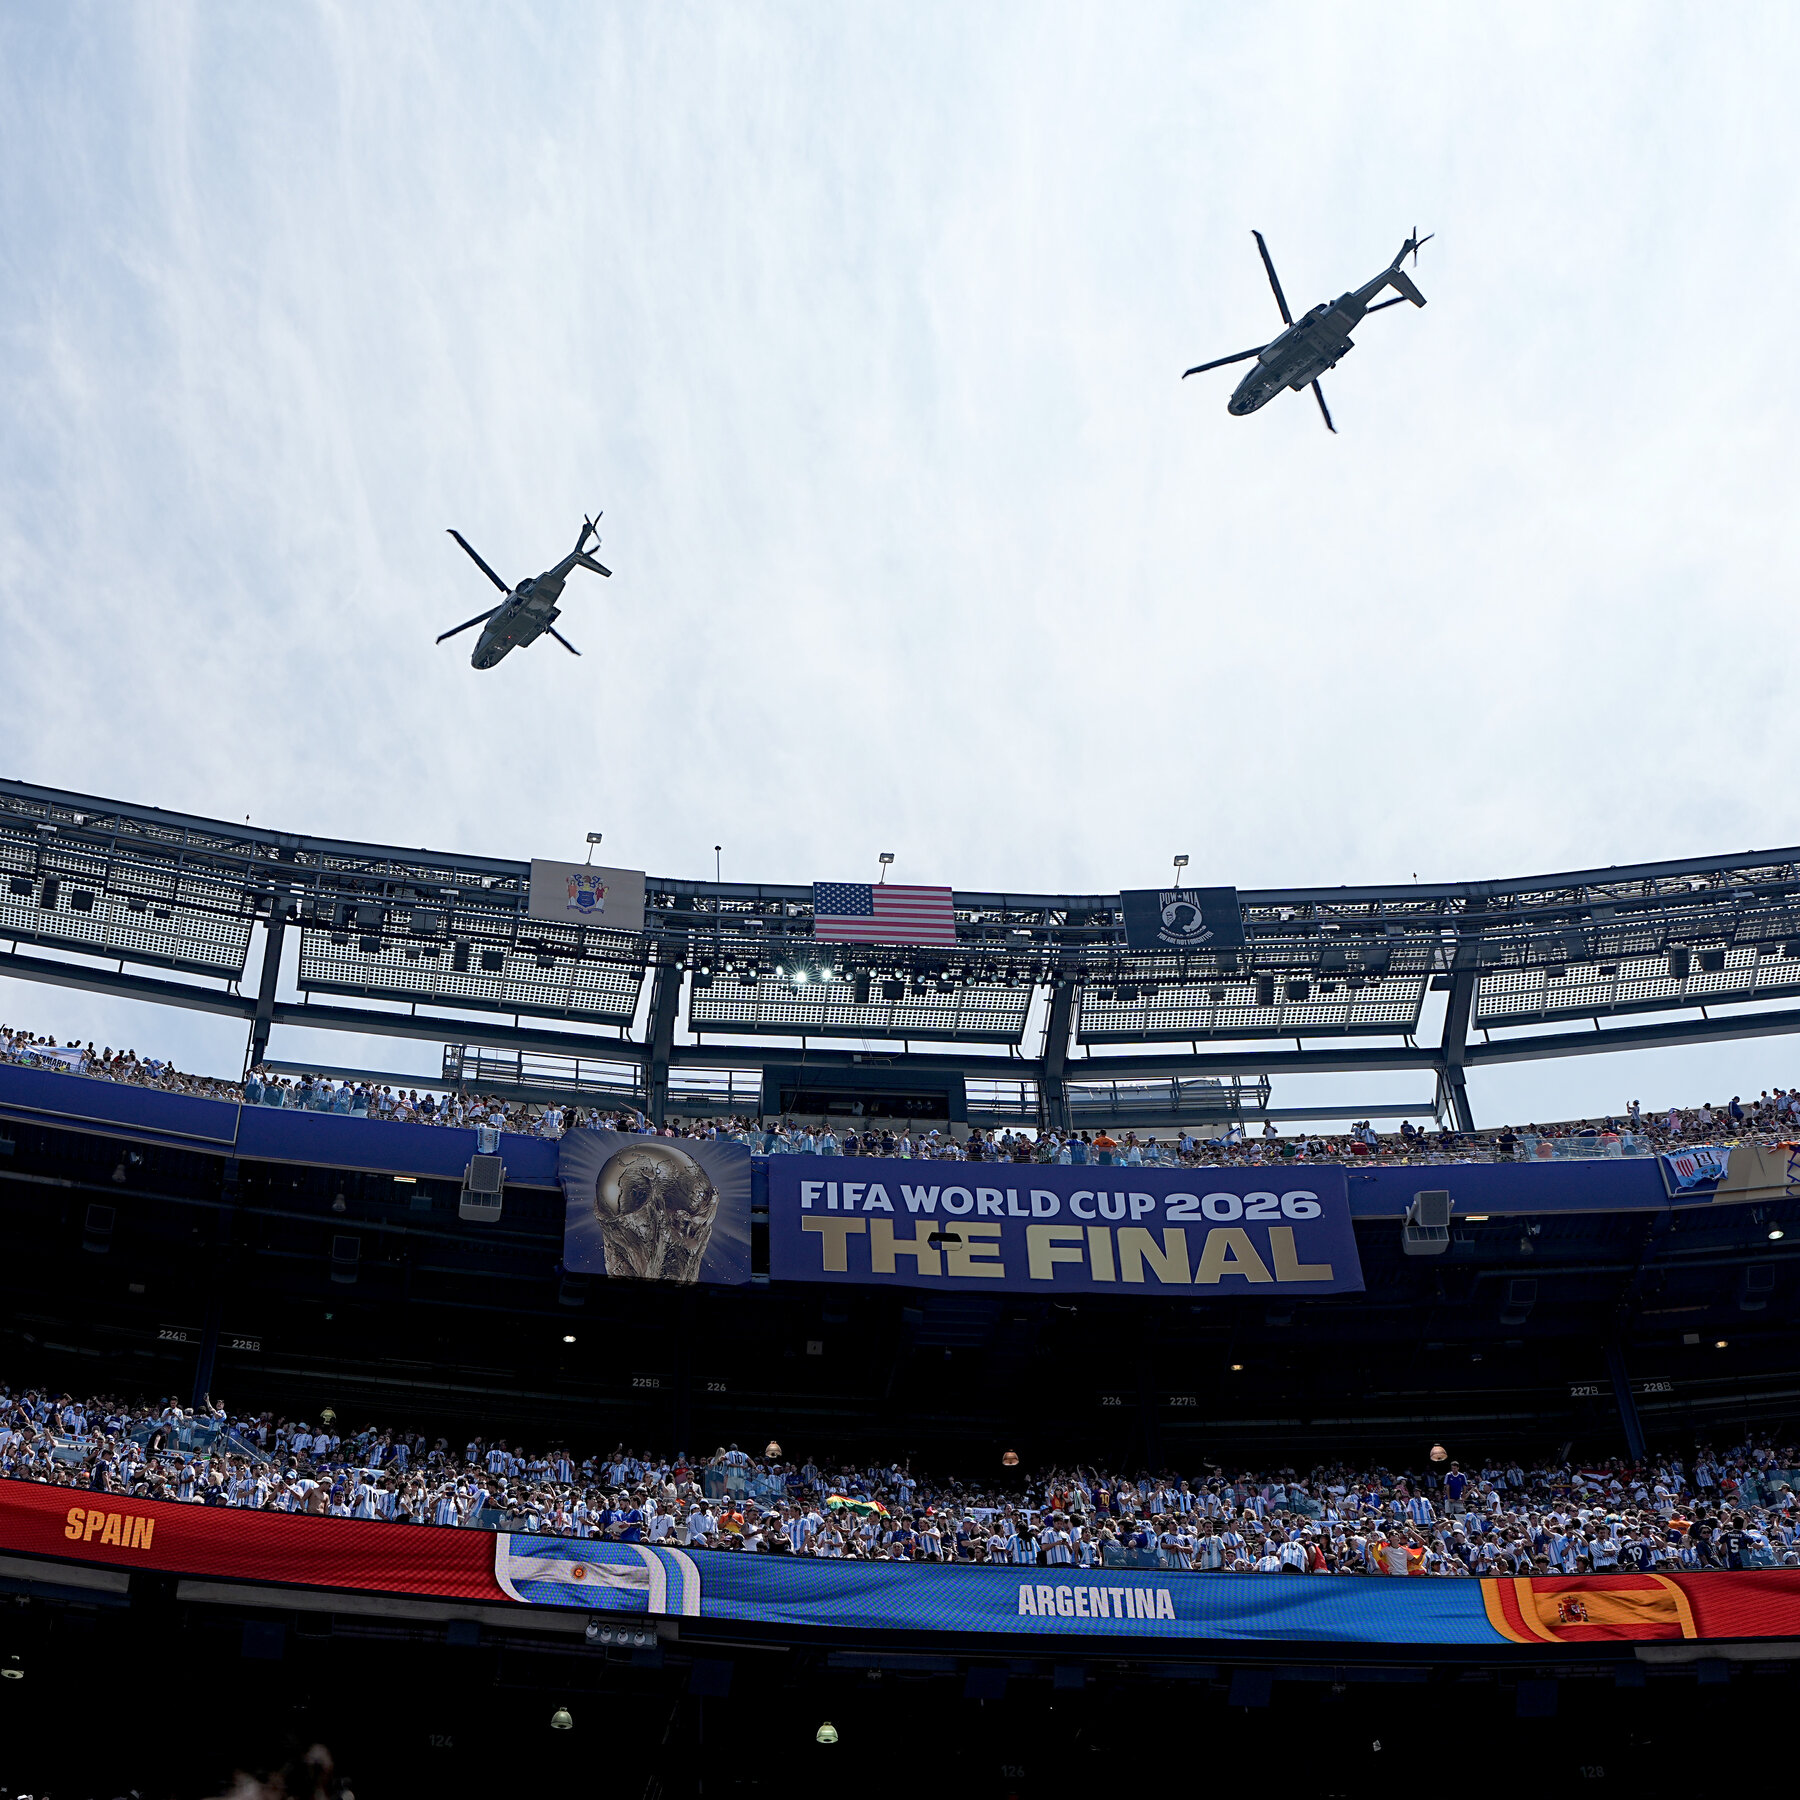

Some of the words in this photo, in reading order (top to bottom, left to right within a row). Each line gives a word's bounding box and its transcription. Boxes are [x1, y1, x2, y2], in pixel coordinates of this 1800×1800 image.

[1159, 892, 1177, 912] POW
[1182, 891, 1201, 910] MIA
[800, 1180, 895, 1212] FIFA
[900, 1184, 1061, 1218] WORLD
[1069, 1190, 1156, 1220] CUP
[1164, 1190, 1322, 1221] 2026
[801, 1215, 1005, 1278] THE
[1025, 1225, 1335, 1284] FINAL
[159, 1330, 187, 1342] 224B
[232, 1339, 261, 1351] 225B
[632, 1377, 660, 1388] 225B
[707, 1382, 727, 1392] 226
[1643, 1381, 1672, 1392] 228B
[1570, 1386, 1599, 1395] 227B
[1102, 1396, 1122, 1406] 226
[1169, 1396, 1197, 1406] 227B
[492, 1454, 501, 1464] 10
[734, 1454, 743, 1464] 10
[368, 1489, 378, 1503] 10
[1100, 1492, 1110, 1504] 10
[64, 1506, 155, 1551] SPAIN
[1019, 1540, 1033, 1552] 10
[1730, 1538, 1739, 1553] 5
[1628, 1546, 1643, 1562] 19
[1018, 1584, 1177, 1620] ARGENTINA
[428, 1733, 453, 1749] 124
[1000, 1764, 1025, 1778] 126
[1579, 1765, 1606, 1779] 128
